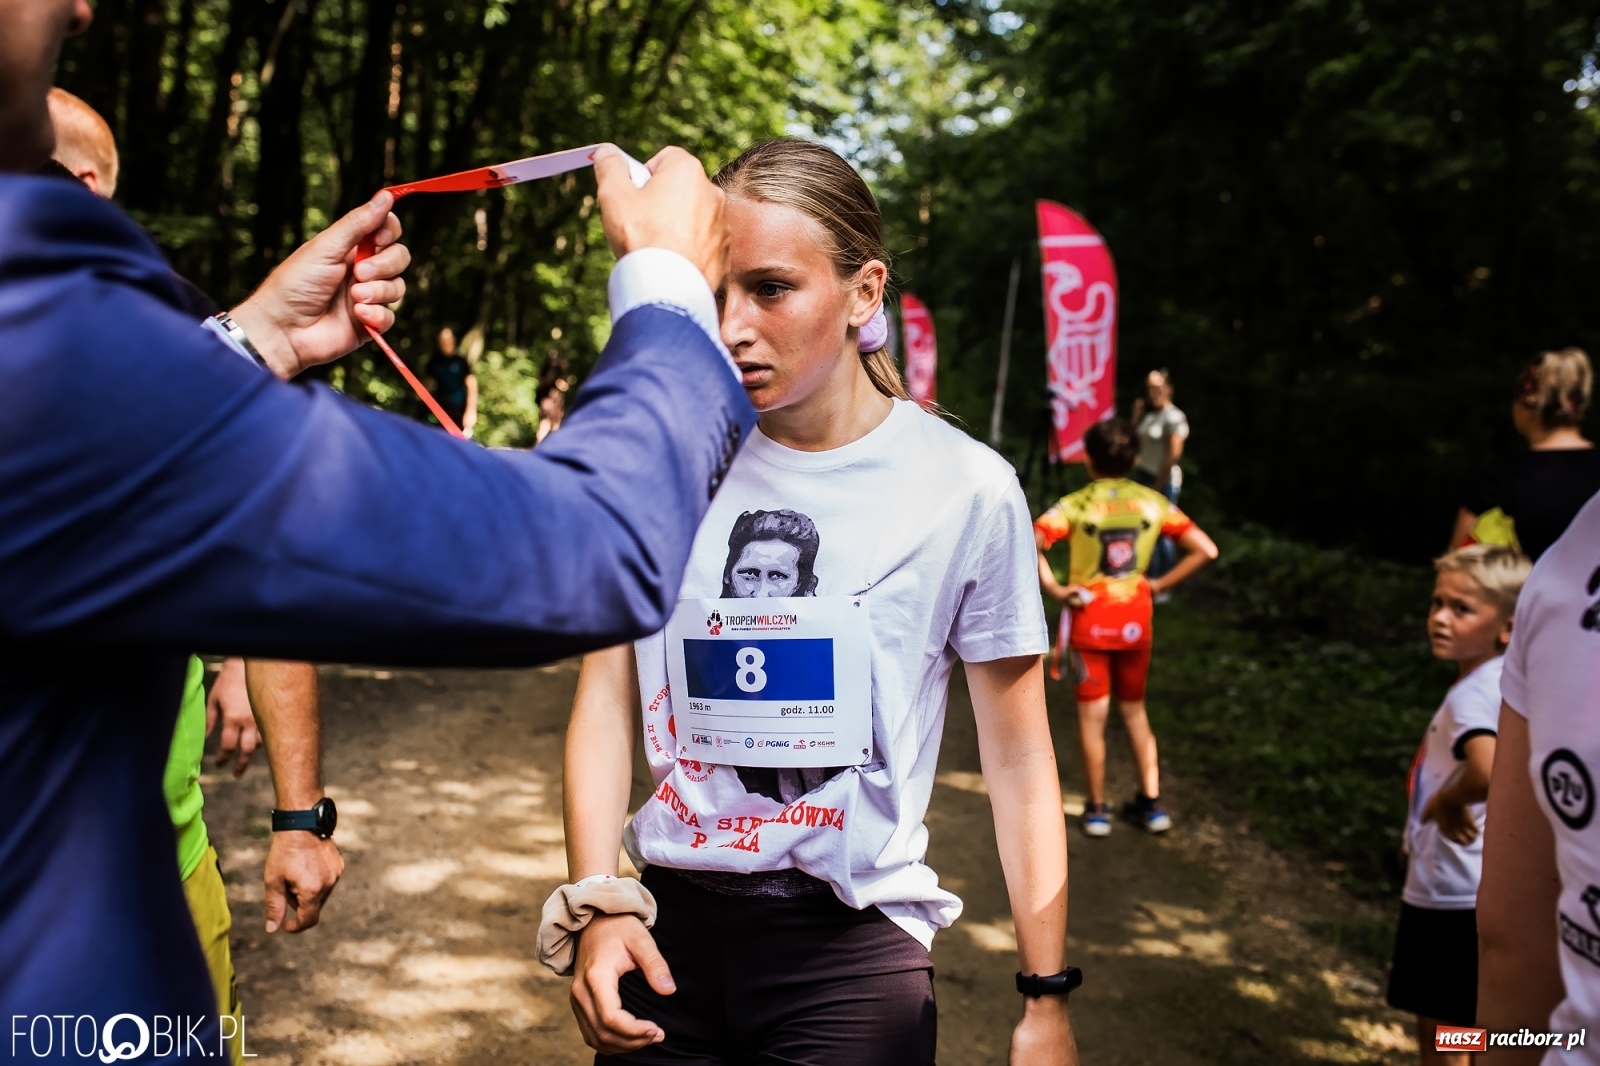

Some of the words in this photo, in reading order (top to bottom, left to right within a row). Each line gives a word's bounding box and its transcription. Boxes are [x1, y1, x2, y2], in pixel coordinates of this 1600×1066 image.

[725, 614, 797, 626] TROPEMWILCZYM
[735, 646, 767, 693] 8
[648, 683, 671, 712] Trope
[689, 702, 704, 711] 1963
[780, 705, 805, 716] godz.
[808, 705, 834, 714] 11.00
[765, 740, 790, 748] PGNiG
[655, 781, 702, 828] NUTA
